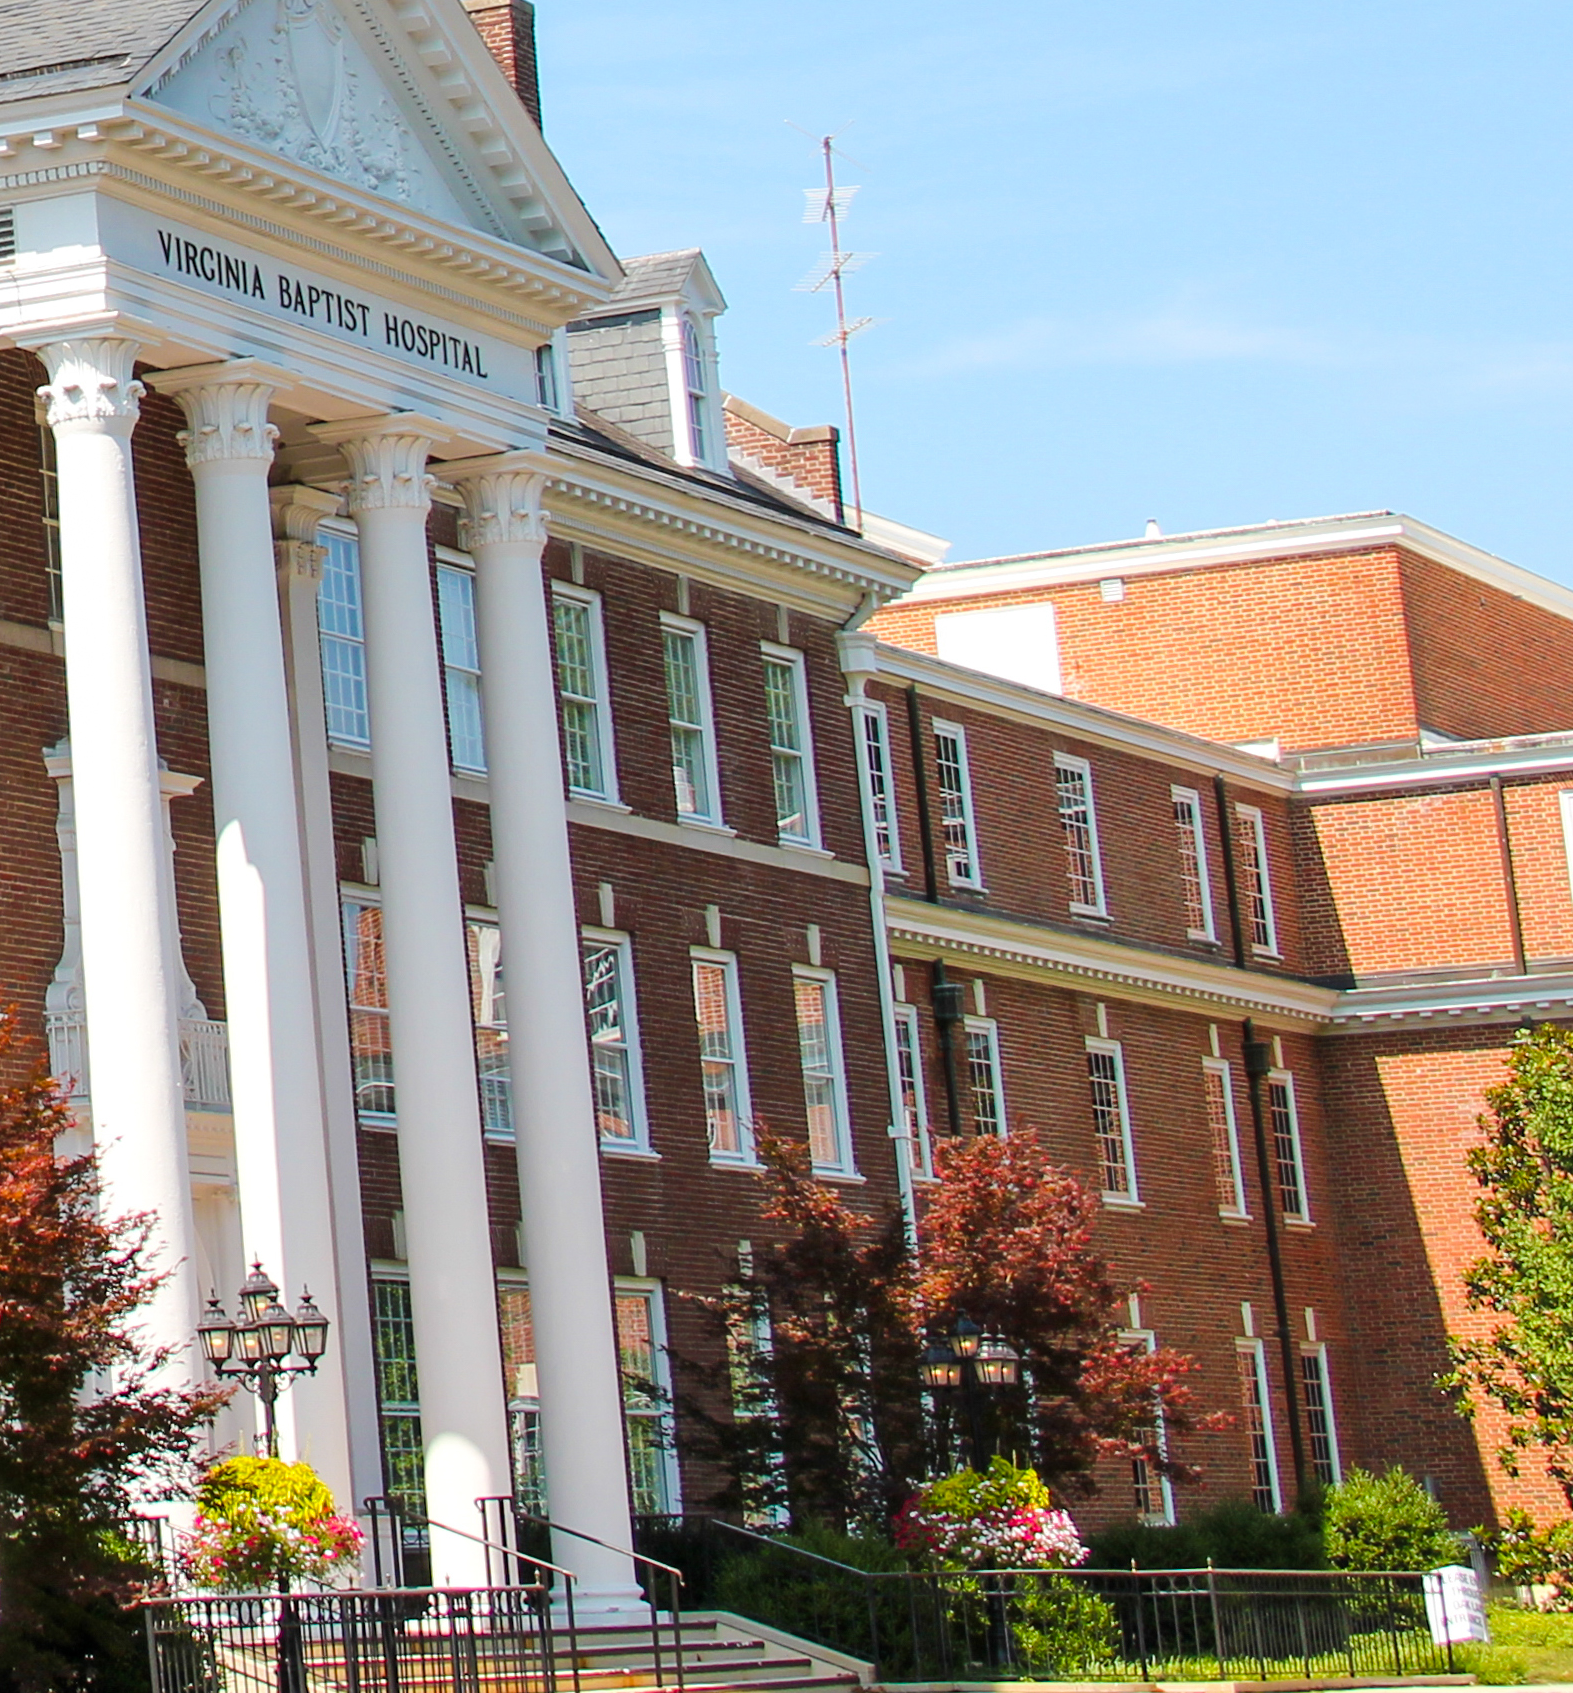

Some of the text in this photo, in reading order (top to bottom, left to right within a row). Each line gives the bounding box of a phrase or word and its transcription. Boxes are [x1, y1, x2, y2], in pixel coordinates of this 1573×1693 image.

[157, 229, 488, 379] VIRGINIA BAPTIST HOSPITAL
